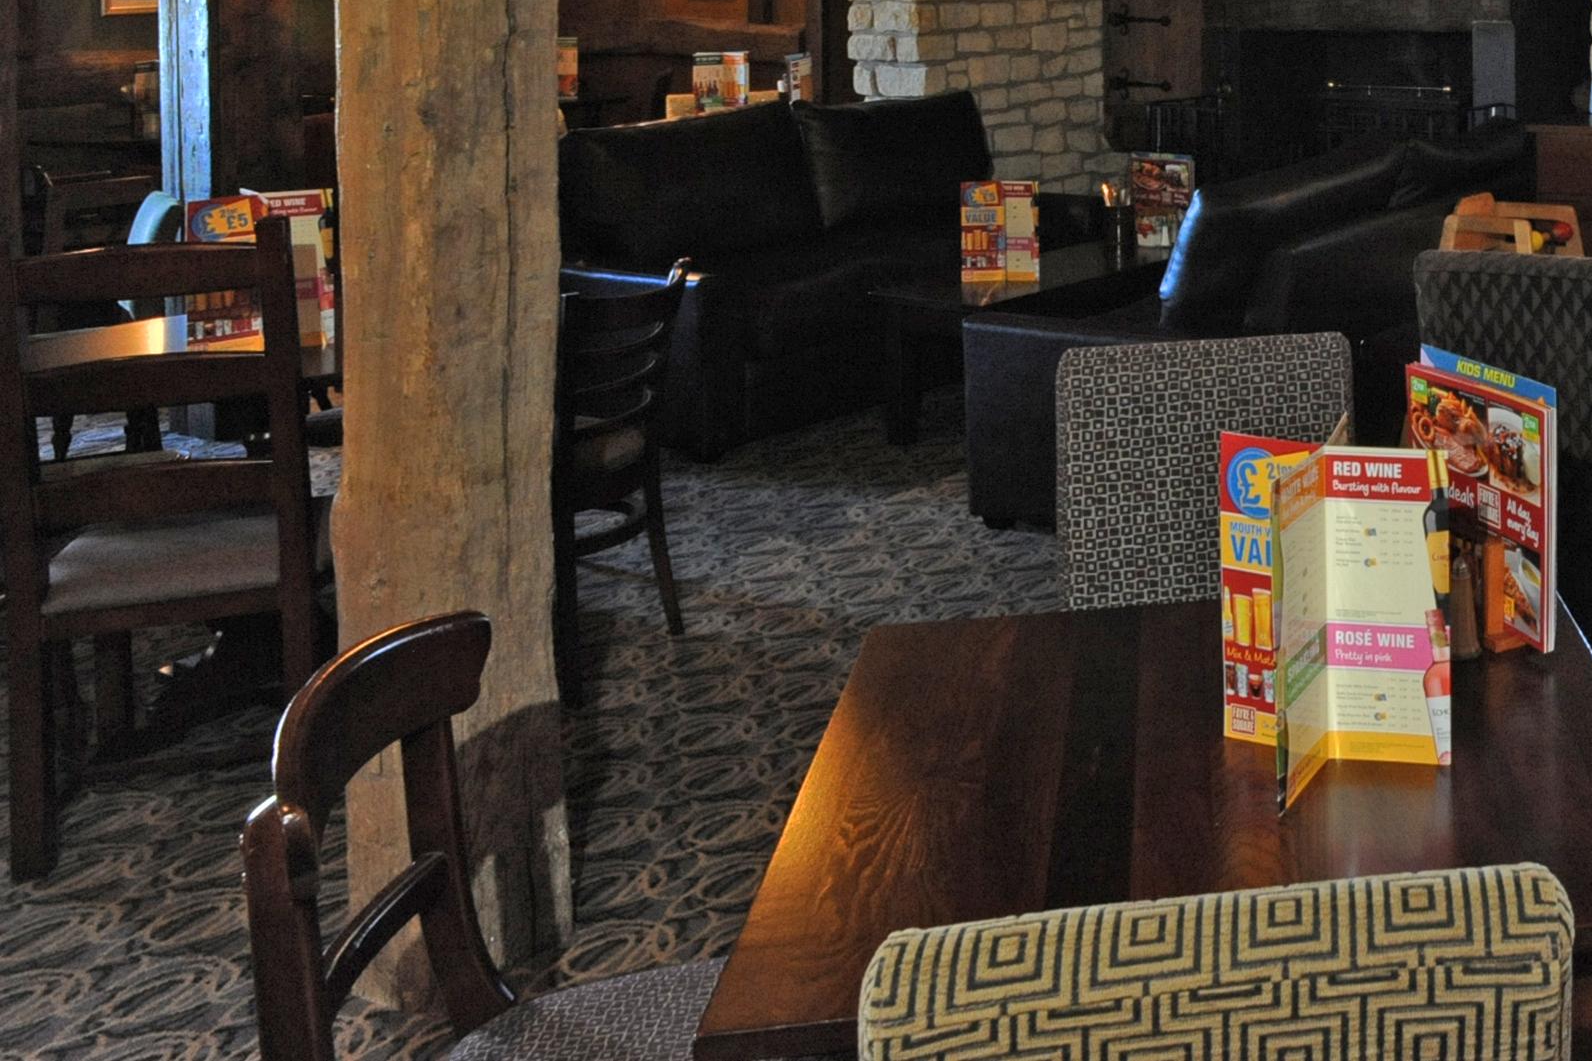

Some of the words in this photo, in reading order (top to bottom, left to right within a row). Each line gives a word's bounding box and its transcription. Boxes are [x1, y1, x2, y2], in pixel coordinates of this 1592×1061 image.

[284, 197, 306, 207] WINE
[226, 214, 249, 230] £5
[1456, 359, 1481, 378] KIDS
[1483, 367, 1516, 388] MENU
[1266, 463, 1276, 481] 2
[1332, 461, 1361, 477] RED
[1365, 462, 1403, 479] WINE
[1332, 479, 1370, 496] Bursting
[1371, 482, 1390, 493] with
[1391, 482, 1422, 495] flavour
[1449, 481, 1475, 508] deals
[1506, 498, 1517, 515] All
[1230, 521, 1263, 535] MOUTH
[1335, 629, 1373, 646] ROSÉ
[1377, 632, 1415, 649] WINE
[1334, 648, 1363, 665] Pretty
[1365, 651, 1374, 660] in
[1375, 651, 1393, 663] pink
